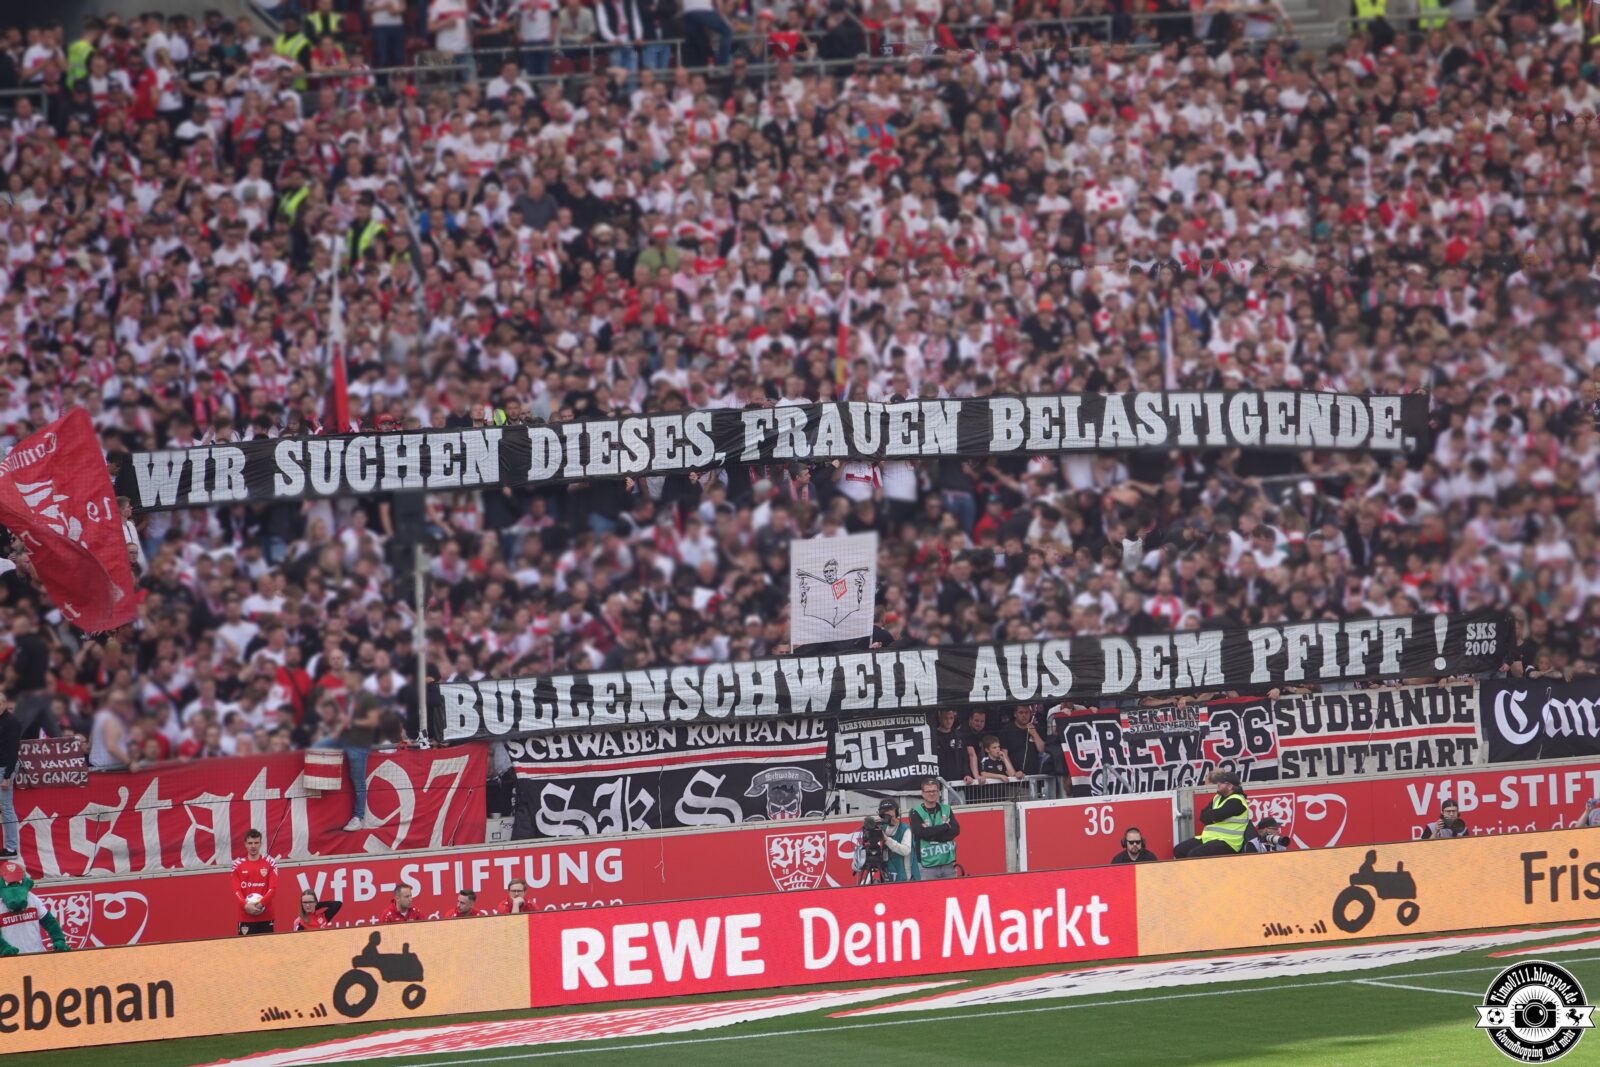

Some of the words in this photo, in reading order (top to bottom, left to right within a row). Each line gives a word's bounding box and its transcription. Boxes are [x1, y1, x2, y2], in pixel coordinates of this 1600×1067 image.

[132, 446, 248, 507] WIR
[274, 428, 502, 497] SUCHEN
[527, 411, 727, 481] DIESES,
[740, 401, 962, 461] FRAUEN
[989, 392, 1416, 453] BELASTIGENDE,
[1465, 640, 1497, 656] 2006
[1466, 622, 1497, 640] SKS
[439, 650, 939, 739] BULLENSCHWEIN
[969, 639, 1073, 701] AUS
[1101, 630, 1225, 694] DEM
[1248, 618, 1413, 687] PFIFF
[1433, 614, 1447, 671] !
[896, 716, 925, 726] ULTRAS
[1274, 685, 1475, 736] SÜDBANDE
[18, 743, 50, 756] TRA
[56, 741, 80, 754] IST
[505, 724, 678, 761] SCHWABEN
[686, 718, 829, 747] KOMPANIE
[835, 725, 938, 771] 50+1
[1209, 706, 1274, 760] 36
[41, 757, 86, 769] KAMPF
[42, 771, 88, 784] GANZE
[836, 765, 939, 784] UNVERHANDELBAR
[1281, 737, 1478, 779] STUTTGART
[1084, 805, 1115, 836] 36
[297, 848, 623, 902] VfB-STIFTUNG
[561, 913, 765, 990] REWE
[799, 903, 921, 969] Dein
[942, 888, 1110, 957] Markt
[0, 975, 174, 1034] ebenan
